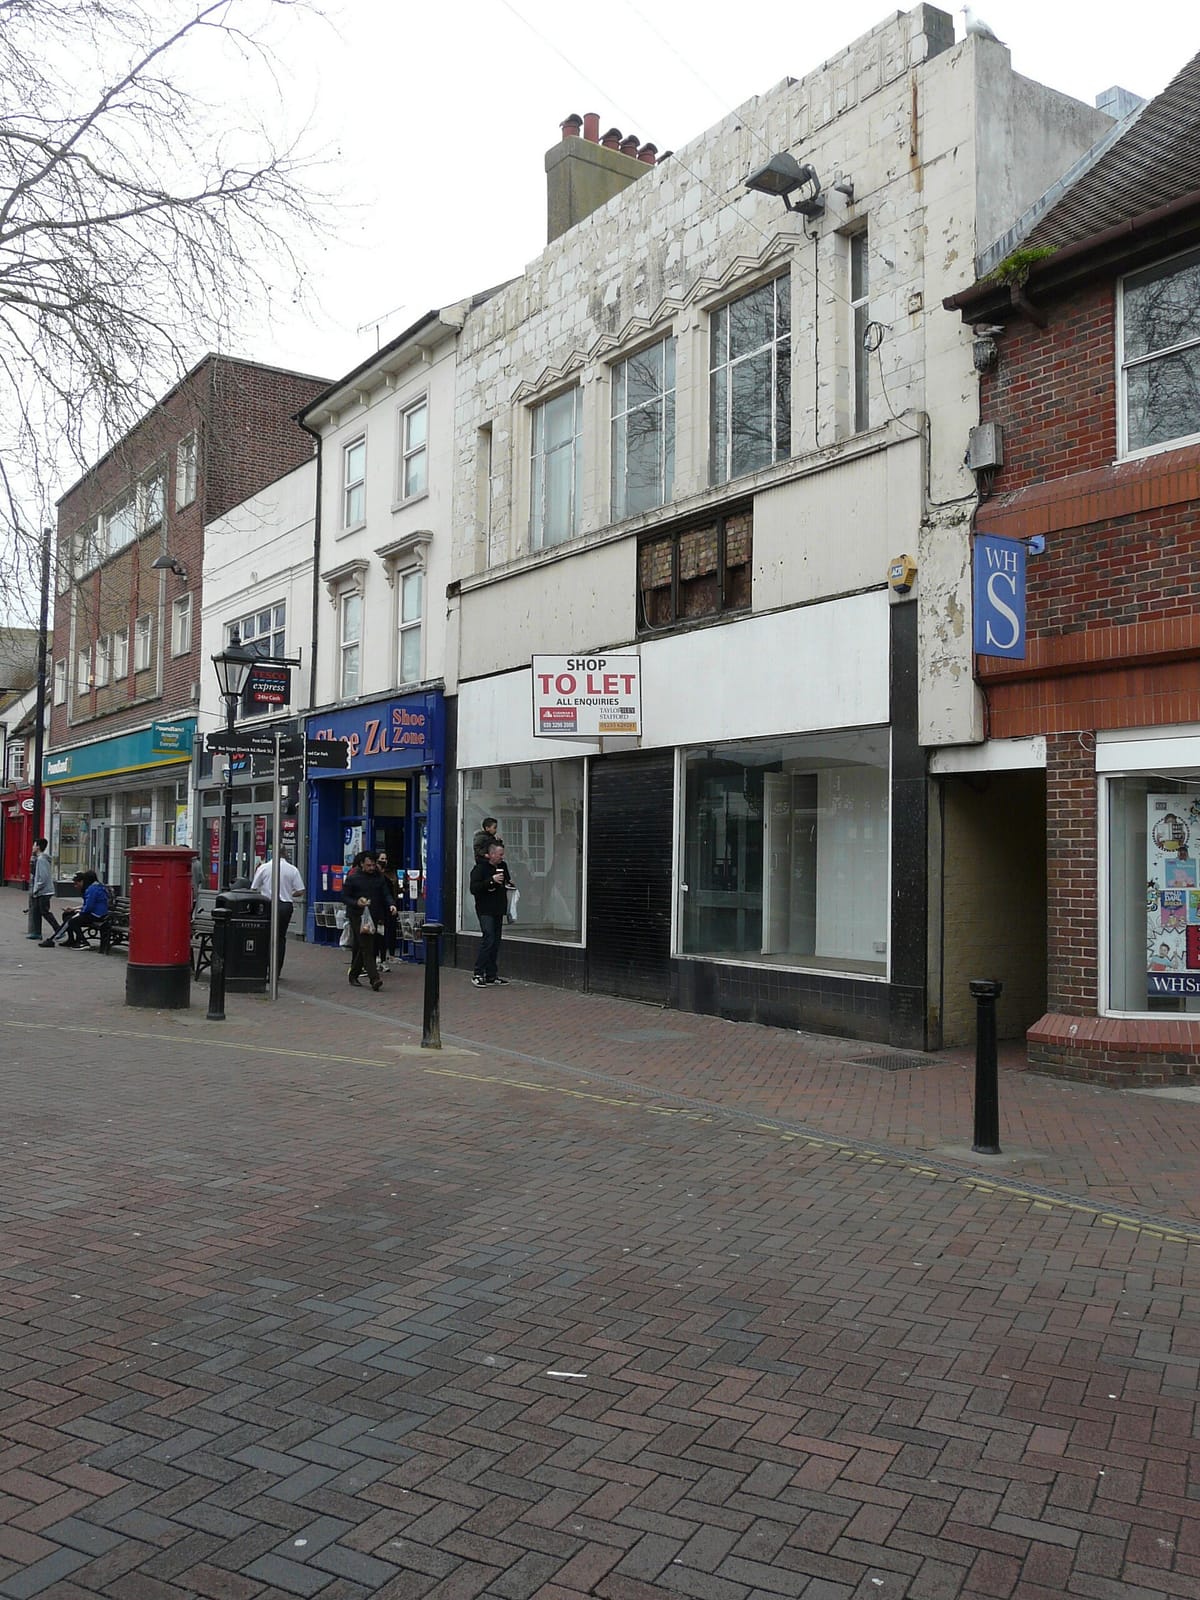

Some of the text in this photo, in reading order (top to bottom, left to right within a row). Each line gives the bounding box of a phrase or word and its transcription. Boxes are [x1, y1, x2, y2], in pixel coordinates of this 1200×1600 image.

[985, 547, 1018, 572] WH
[986, 571, 1020, 649] S
[567, 659, 606, 671] SHOP
[254, 671, 287, 680] TESCO
[537, 673, 636, 695] TO LET
[252, 682, 286, 692] express
[556, 698, 619, 707] ALL ENQUIRIES
[392, 708, 425, 726] Shoe
[392, 727, 425, 745] Zone
